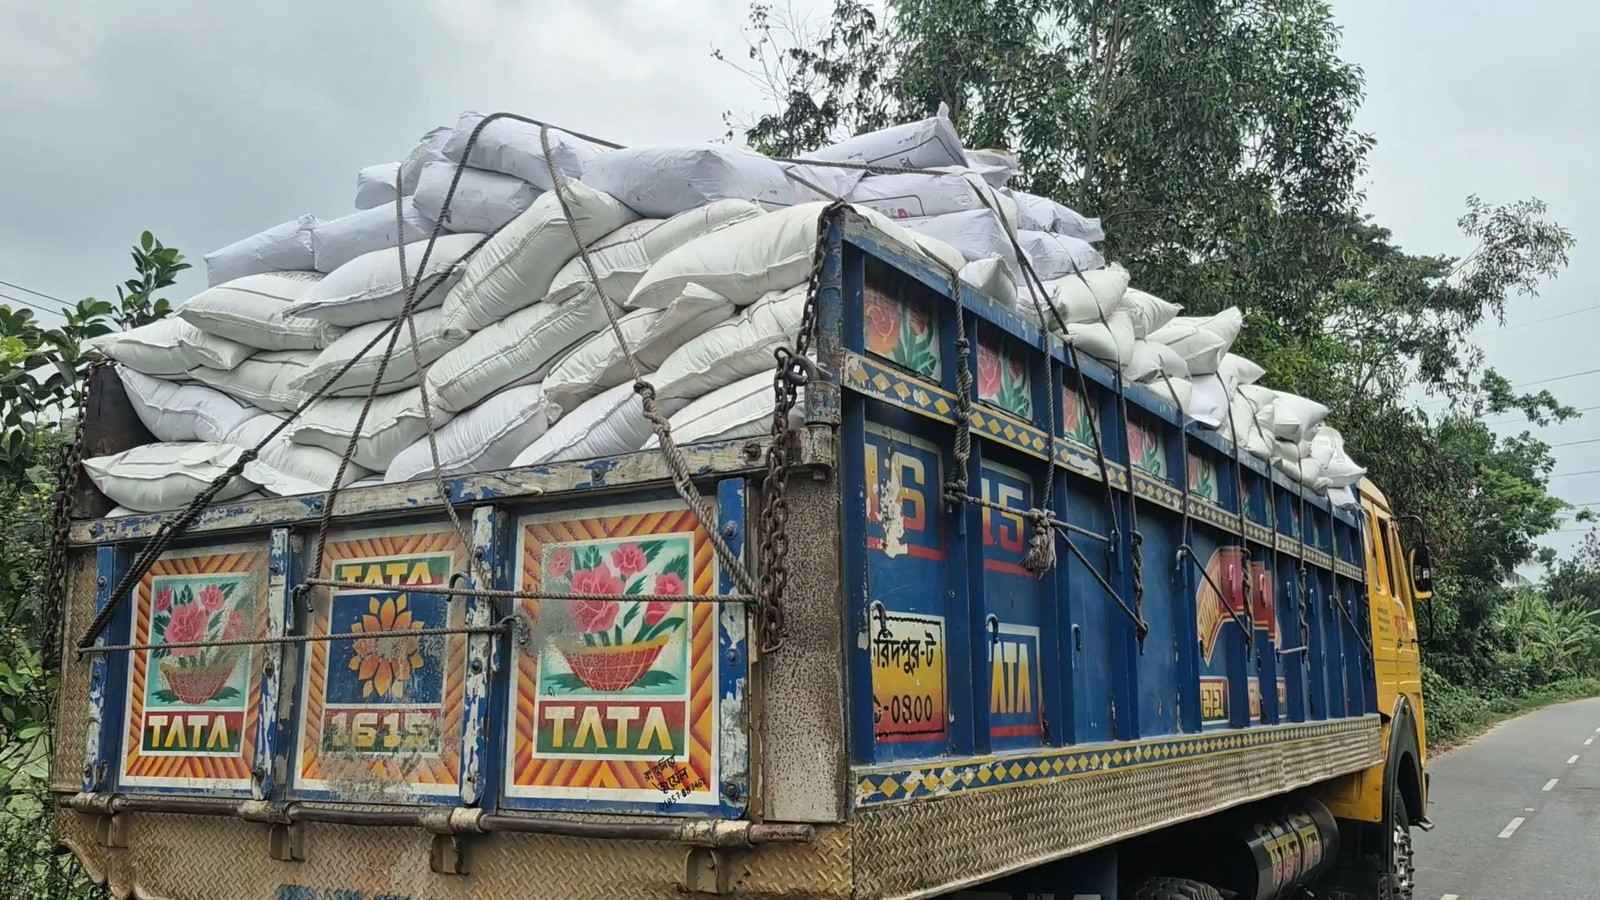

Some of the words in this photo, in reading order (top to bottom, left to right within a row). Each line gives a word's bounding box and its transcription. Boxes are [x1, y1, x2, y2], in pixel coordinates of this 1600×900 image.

[981, 478, 1024, 553] 15
[341, 561, 433, 586] TATA
[873, 629, 937, 676] রিদপুর-ট
[147, 714, 230, 749] TATA
[331, 711, 433, 748] 1615
[544, 705, 674, 751] TATA
